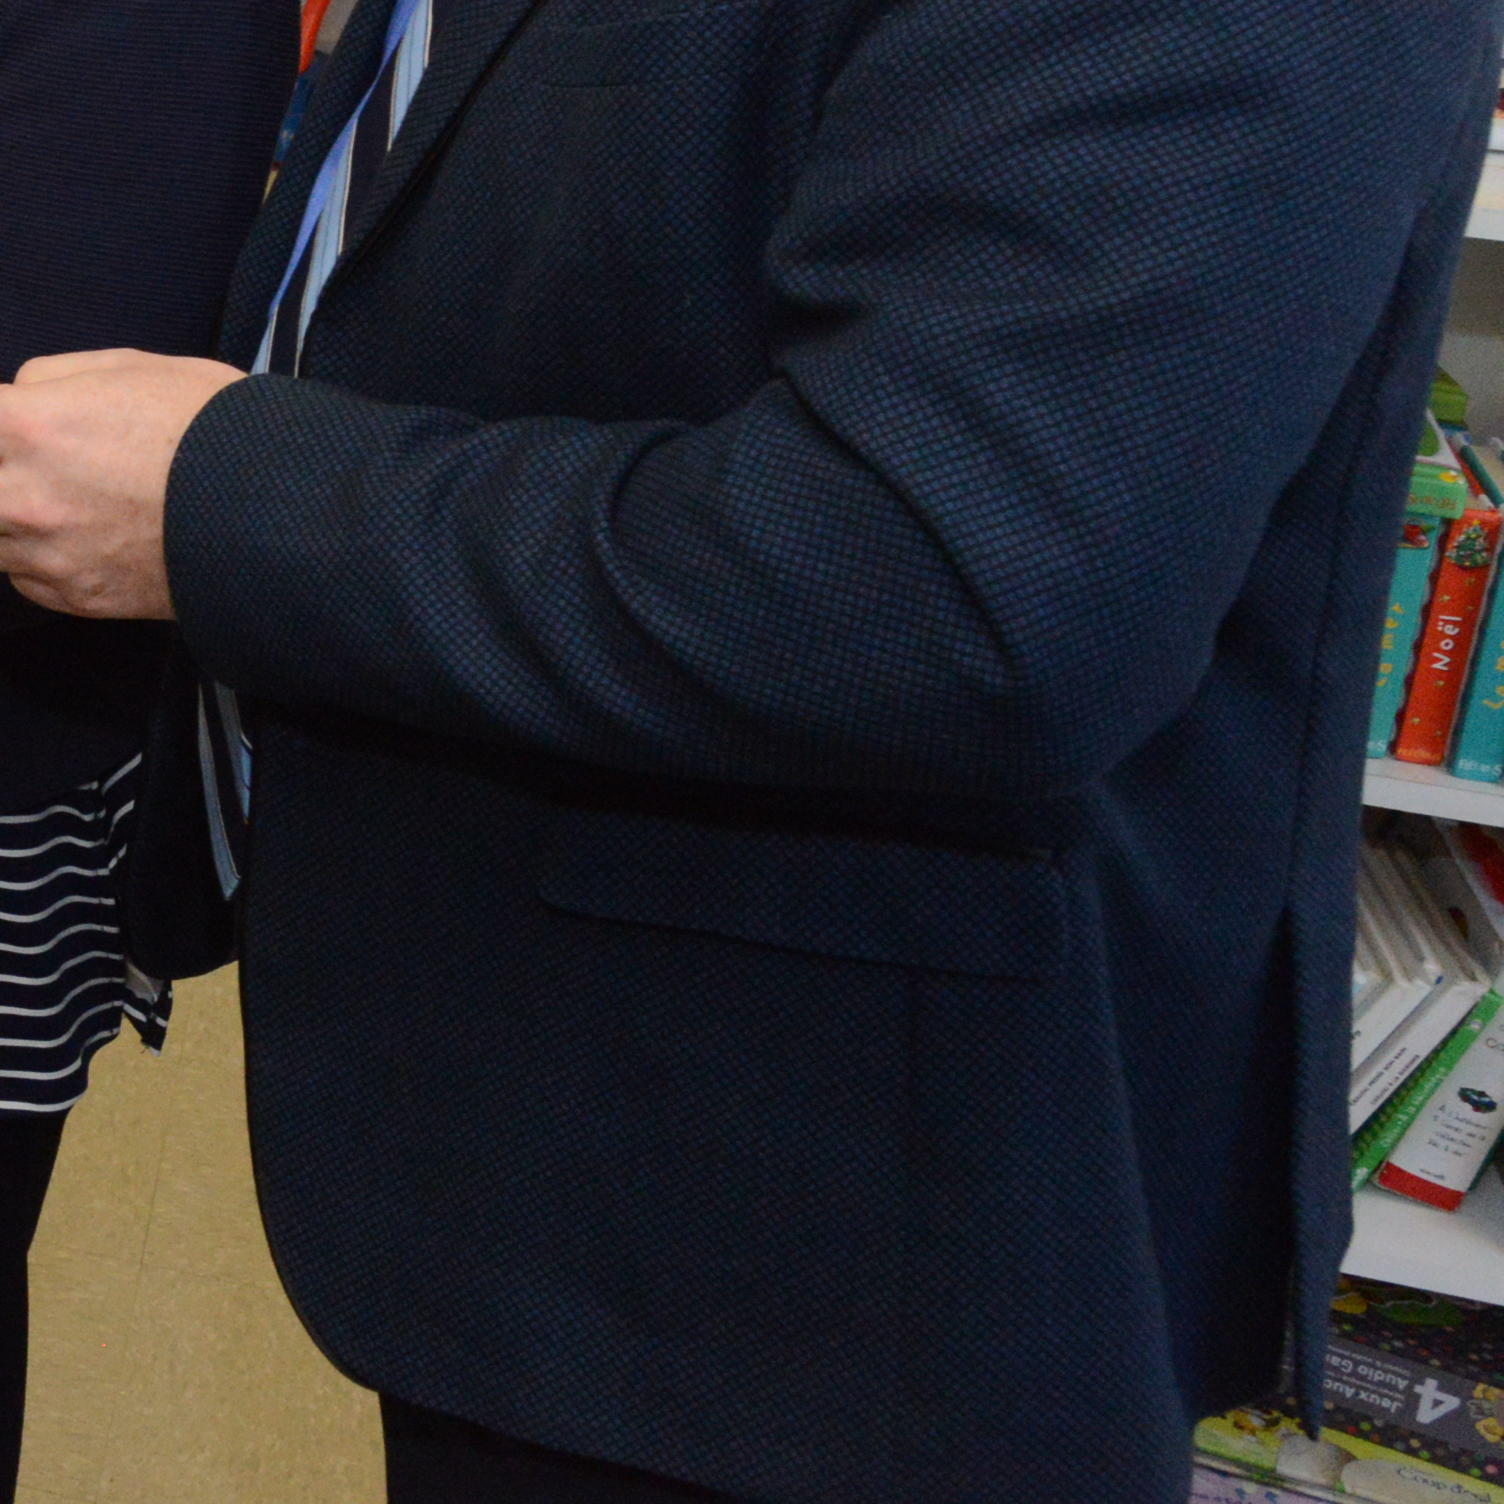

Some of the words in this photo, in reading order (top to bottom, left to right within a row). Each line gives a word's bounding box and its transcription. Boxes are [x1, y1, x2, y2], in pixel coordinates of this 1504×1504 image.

[1430, 613, 1463, 671] Noël
[1356, 1363, 1410, 1390] Audio
[1359, 1388, 1404, 1414] Jeux
[1412, 1376, 1461, 1425] 4
